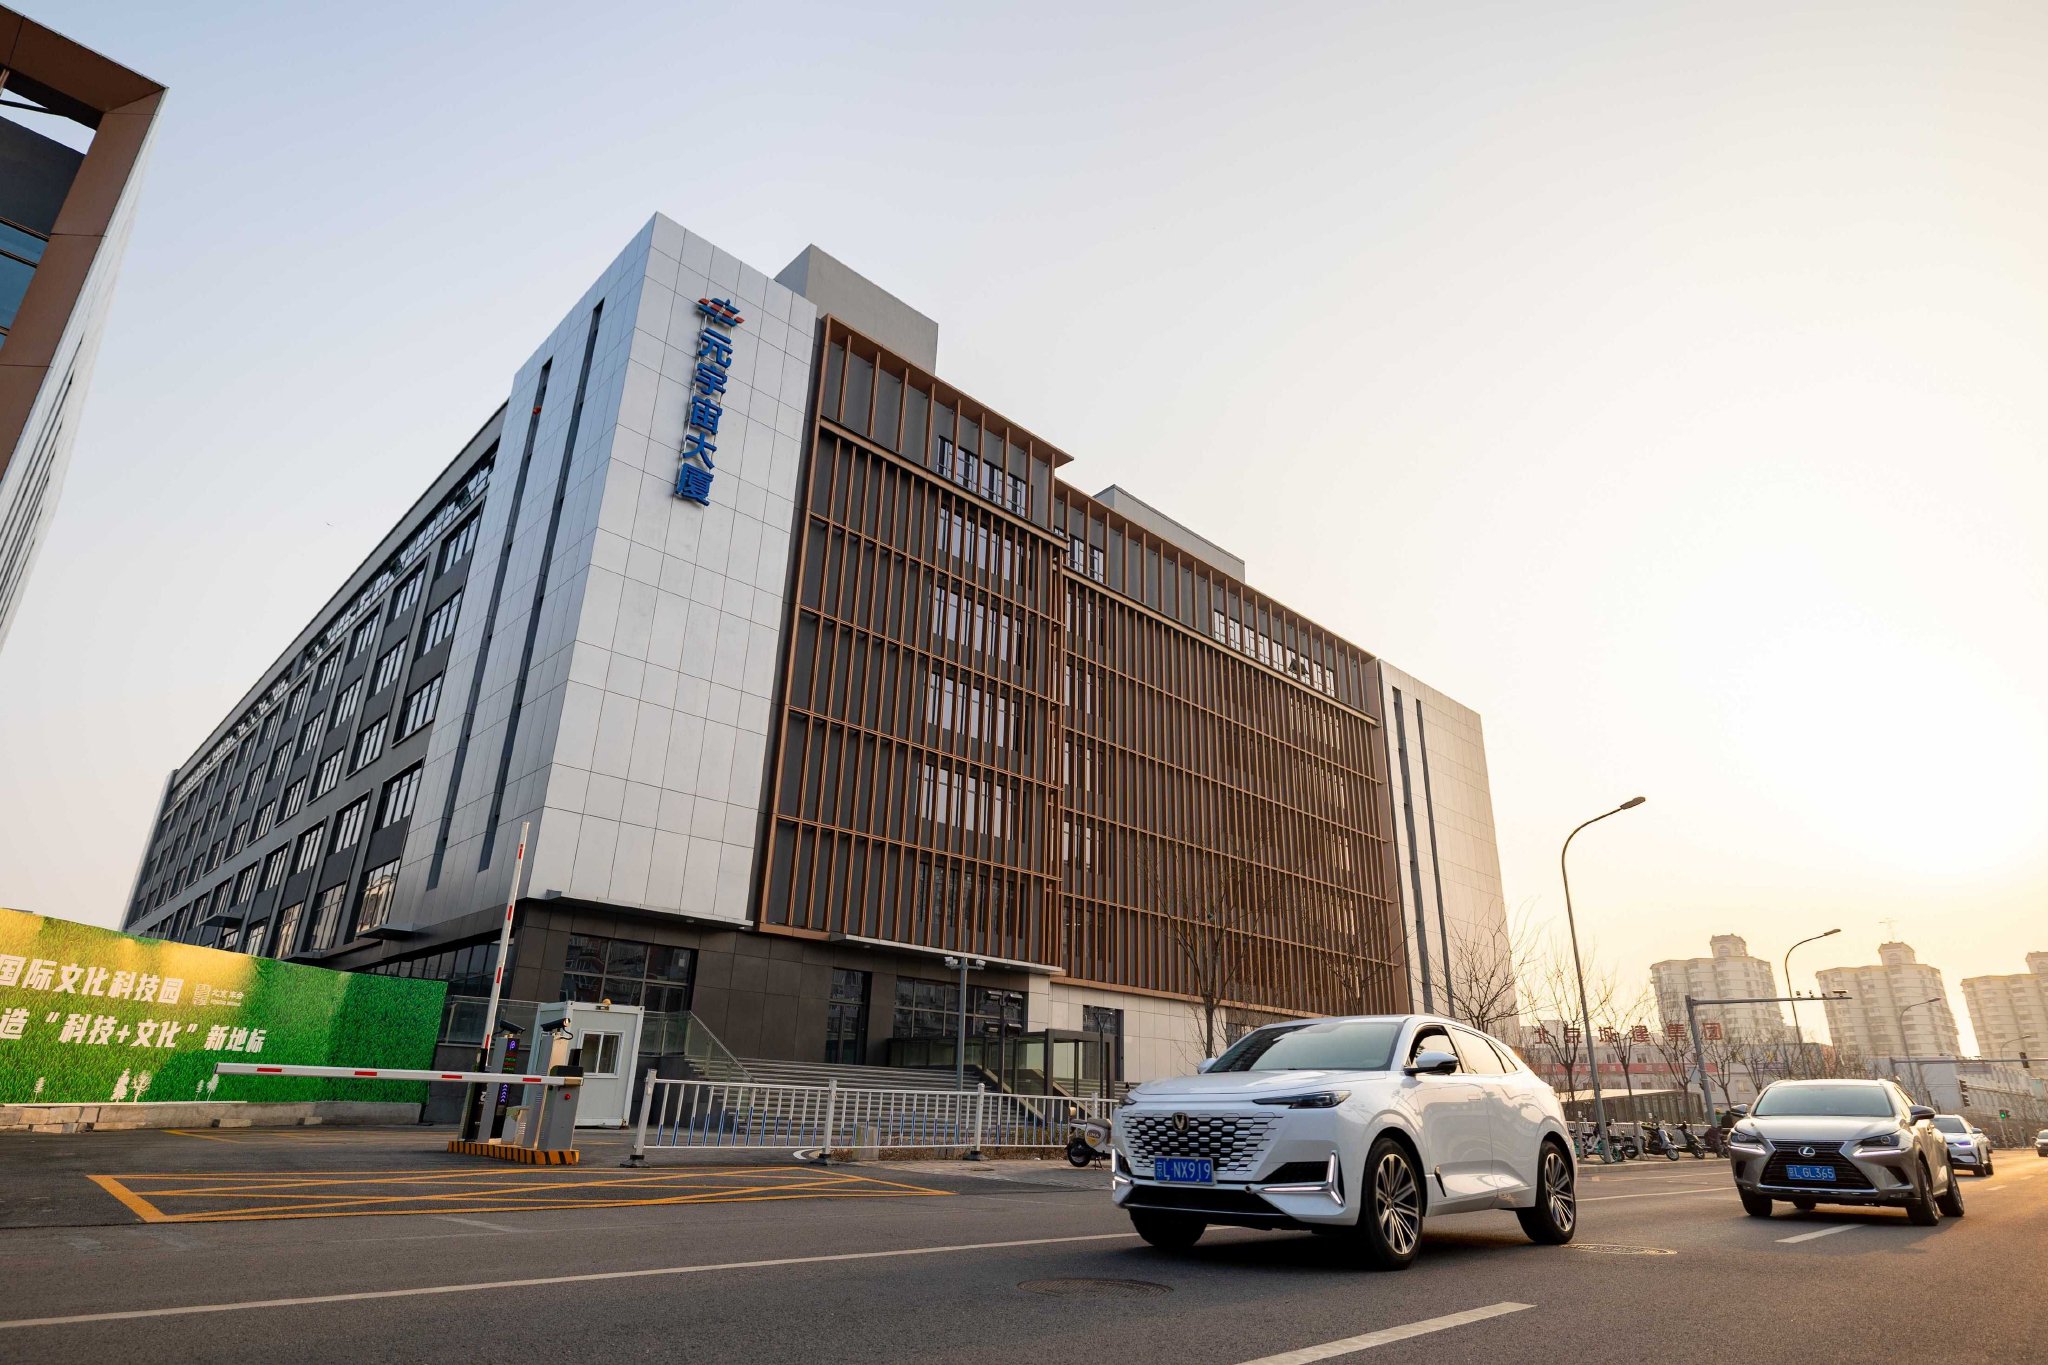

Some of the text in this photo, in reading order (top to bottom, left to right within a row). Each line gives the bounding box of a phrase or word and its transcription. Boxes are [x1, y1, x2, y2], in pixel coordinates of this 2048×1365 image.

[676, 327, 733, 507] 元宇宙大厦
[0, 953, 184, 1005] 国际文化科技园
[1534, 1022, 1723, 1045] 北京城建集团
